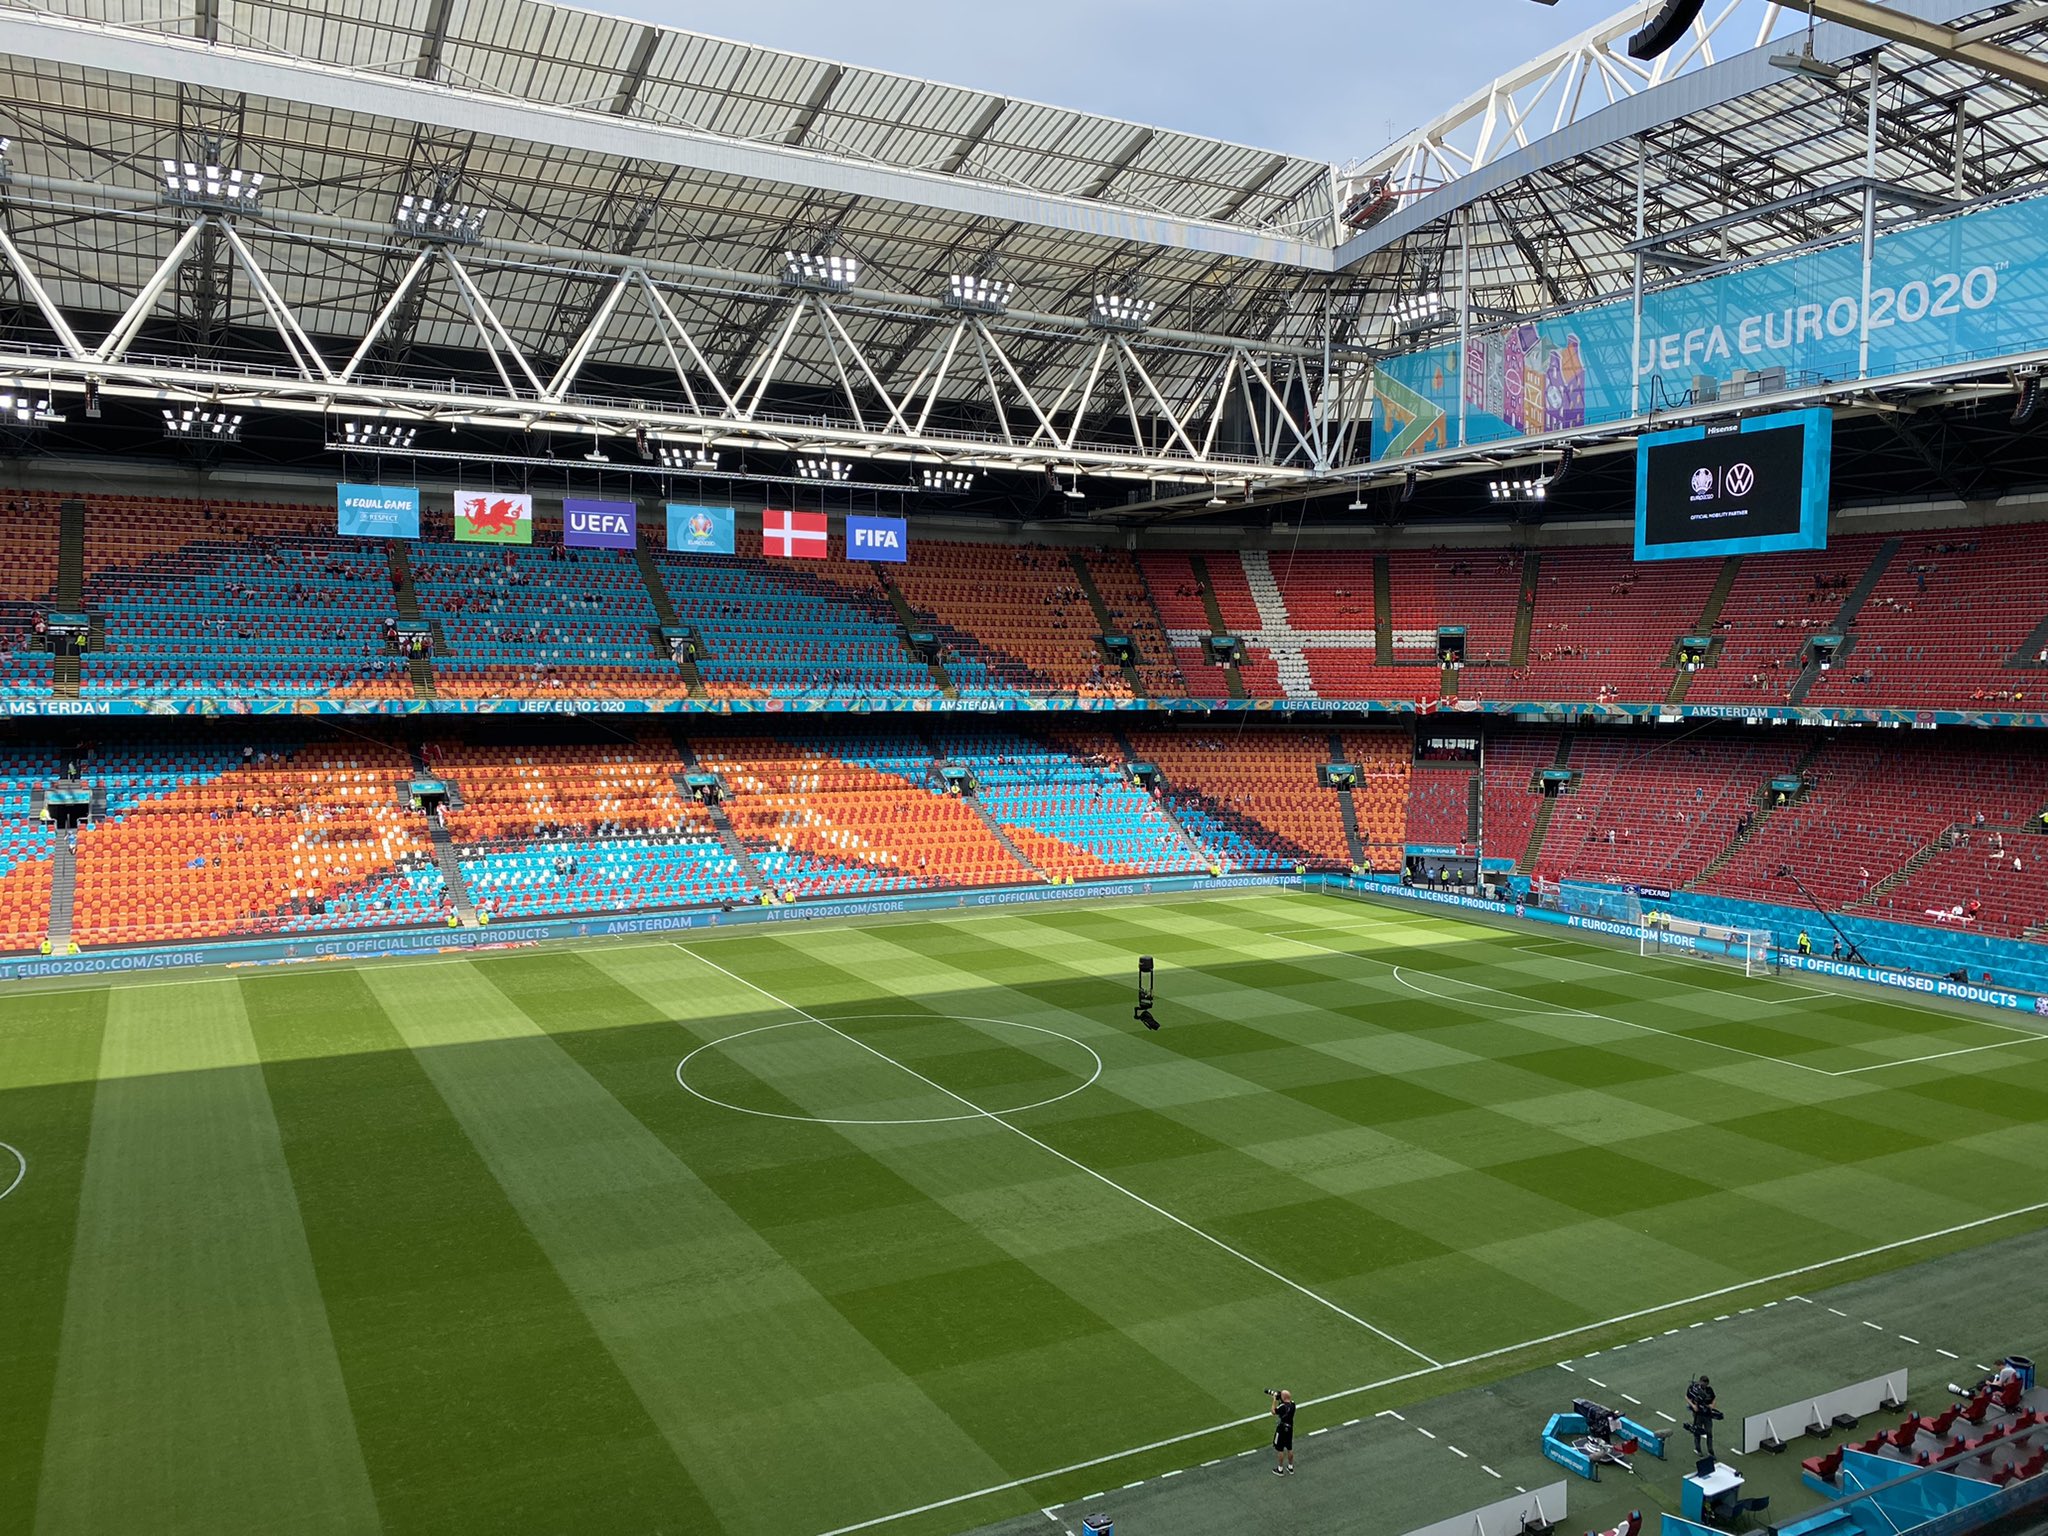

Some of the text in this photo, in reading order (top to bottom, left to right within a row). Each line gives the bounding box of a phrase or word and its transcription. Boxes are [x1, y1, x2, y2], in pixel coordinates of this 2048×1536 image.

[1631, 325, 1731, 375] UEFA
[1738, 297, 1858, 355] EURO
[1868, 266, 1997, 330] 2020
[1708, 425, 1738, 435] Hisense
[344, 498, 413, 511] #EQUAL GAME
[570, 512, 629, 533] UEFA
[855, 529, 899, 548] FIFA
[0, 702, 110, 714] AMSTERDAM
[518, 701, 626, 712] UEFA EURO 2020
[940, 701, 1004, 711] AMSTERDAM
[1282, 701, 1369, 710] UEFA EURO 2020
[1691, 706, 1768, 718] AMSTERDAM
[1192, 875, 1302, 889] AT EURO2020.COM/STORE
[978, 884, 1134, 905] GET OFFICIAL LICENSED PRODUCTS
[1364, 881, 1506, 913] GET OFFICIAL LICENSED PRODUCTS
[1640, 887, 1670, 898] SPEXARD
[767, 901, 904, 921] AT EURO2020.COM/STORE
[607, 916, 692, 934] AMSTERDAM
[1568, 915, 1580, 926] AT
[315, 927, 550, 955] GET OFFICIAL LICENSED PRODUCTS
[0, 953, 204, 978] T EURO2020.COM/STORE
[1780, 953, 2018, 1008] GET OFFICIAL LICENSED PRODUCTS
